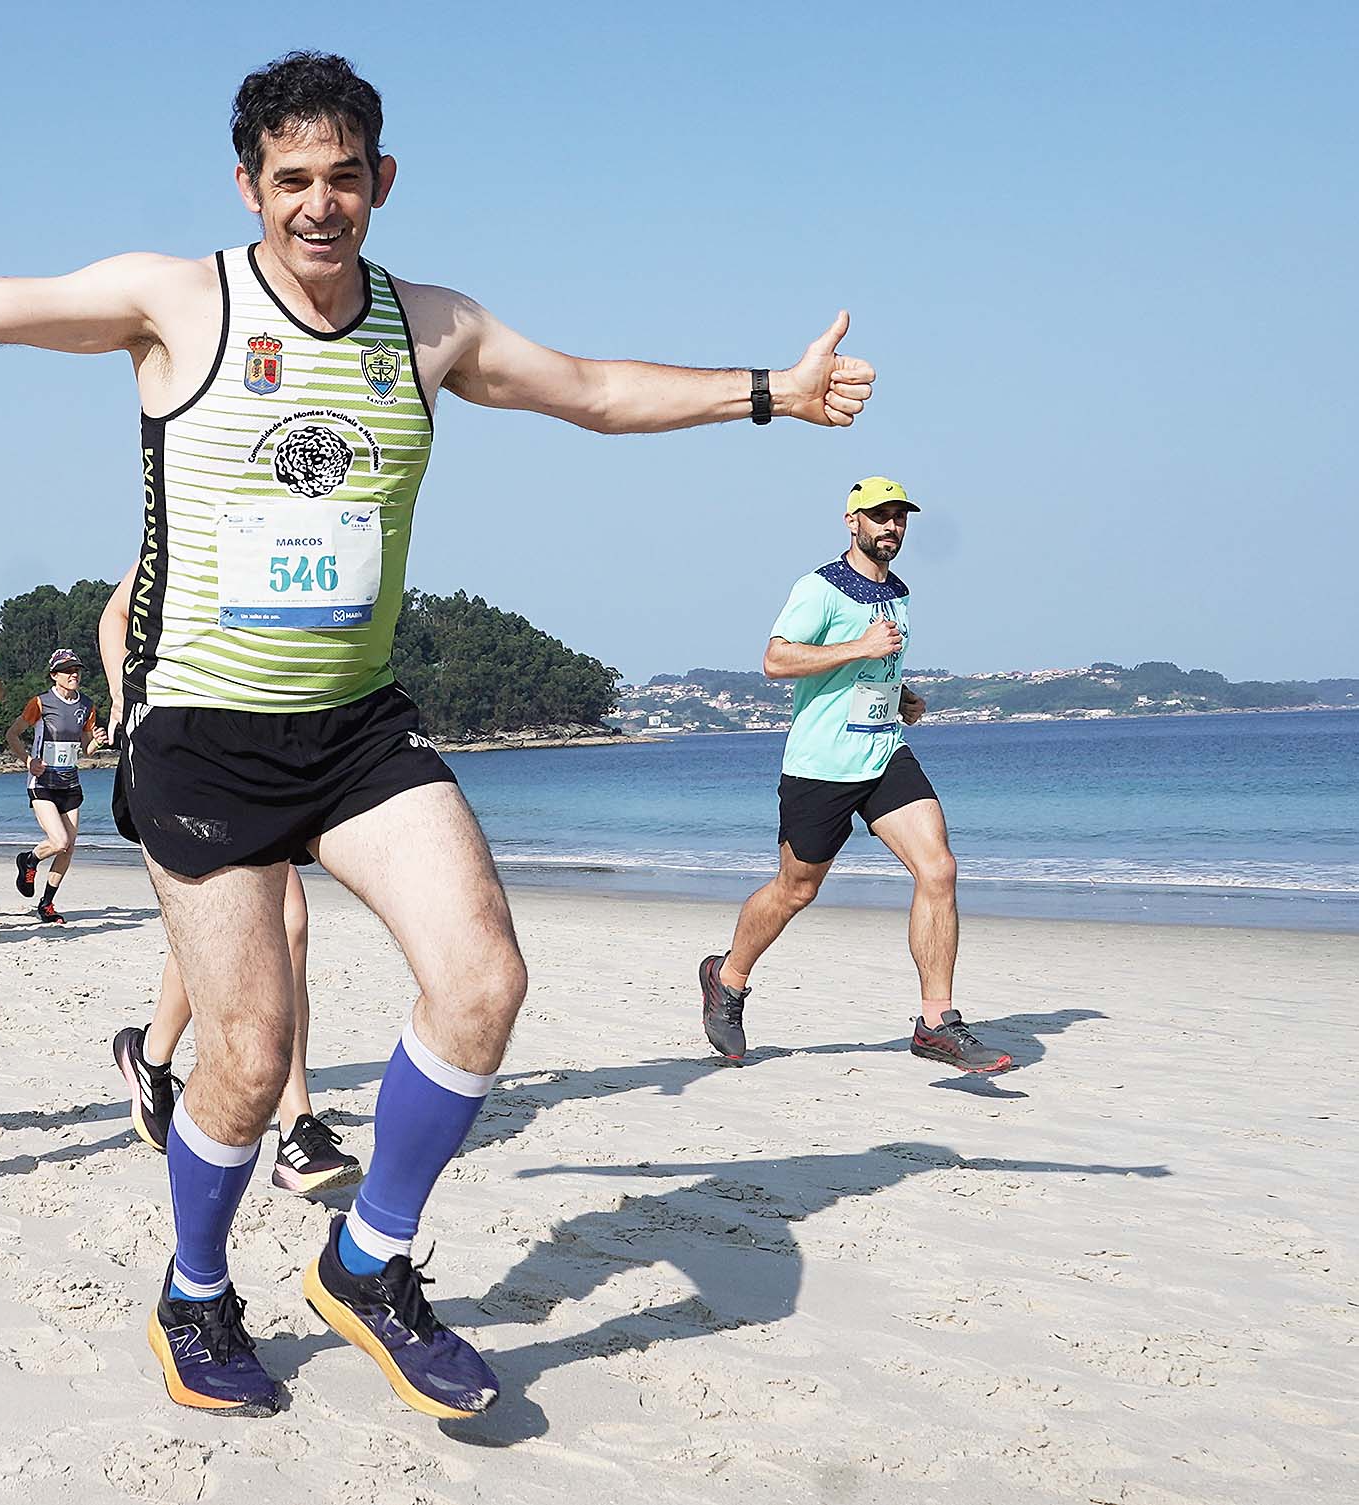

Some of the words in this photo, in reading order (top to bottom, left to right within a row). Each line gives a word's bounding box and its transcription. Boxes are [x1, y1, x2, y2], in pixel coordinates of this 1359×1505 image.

[248, 422, 283, 463] Comunidade
[282, 417, 293, 425] de
[293, 410, 324, 420] Montes
[362, 429, 376, 447] Man
[276, 537, 323, 547] MARCOS
[269, 555, 339, 592] 546
[868, 702, 889, 720] 239
[57, 754, 68, 763] 67
